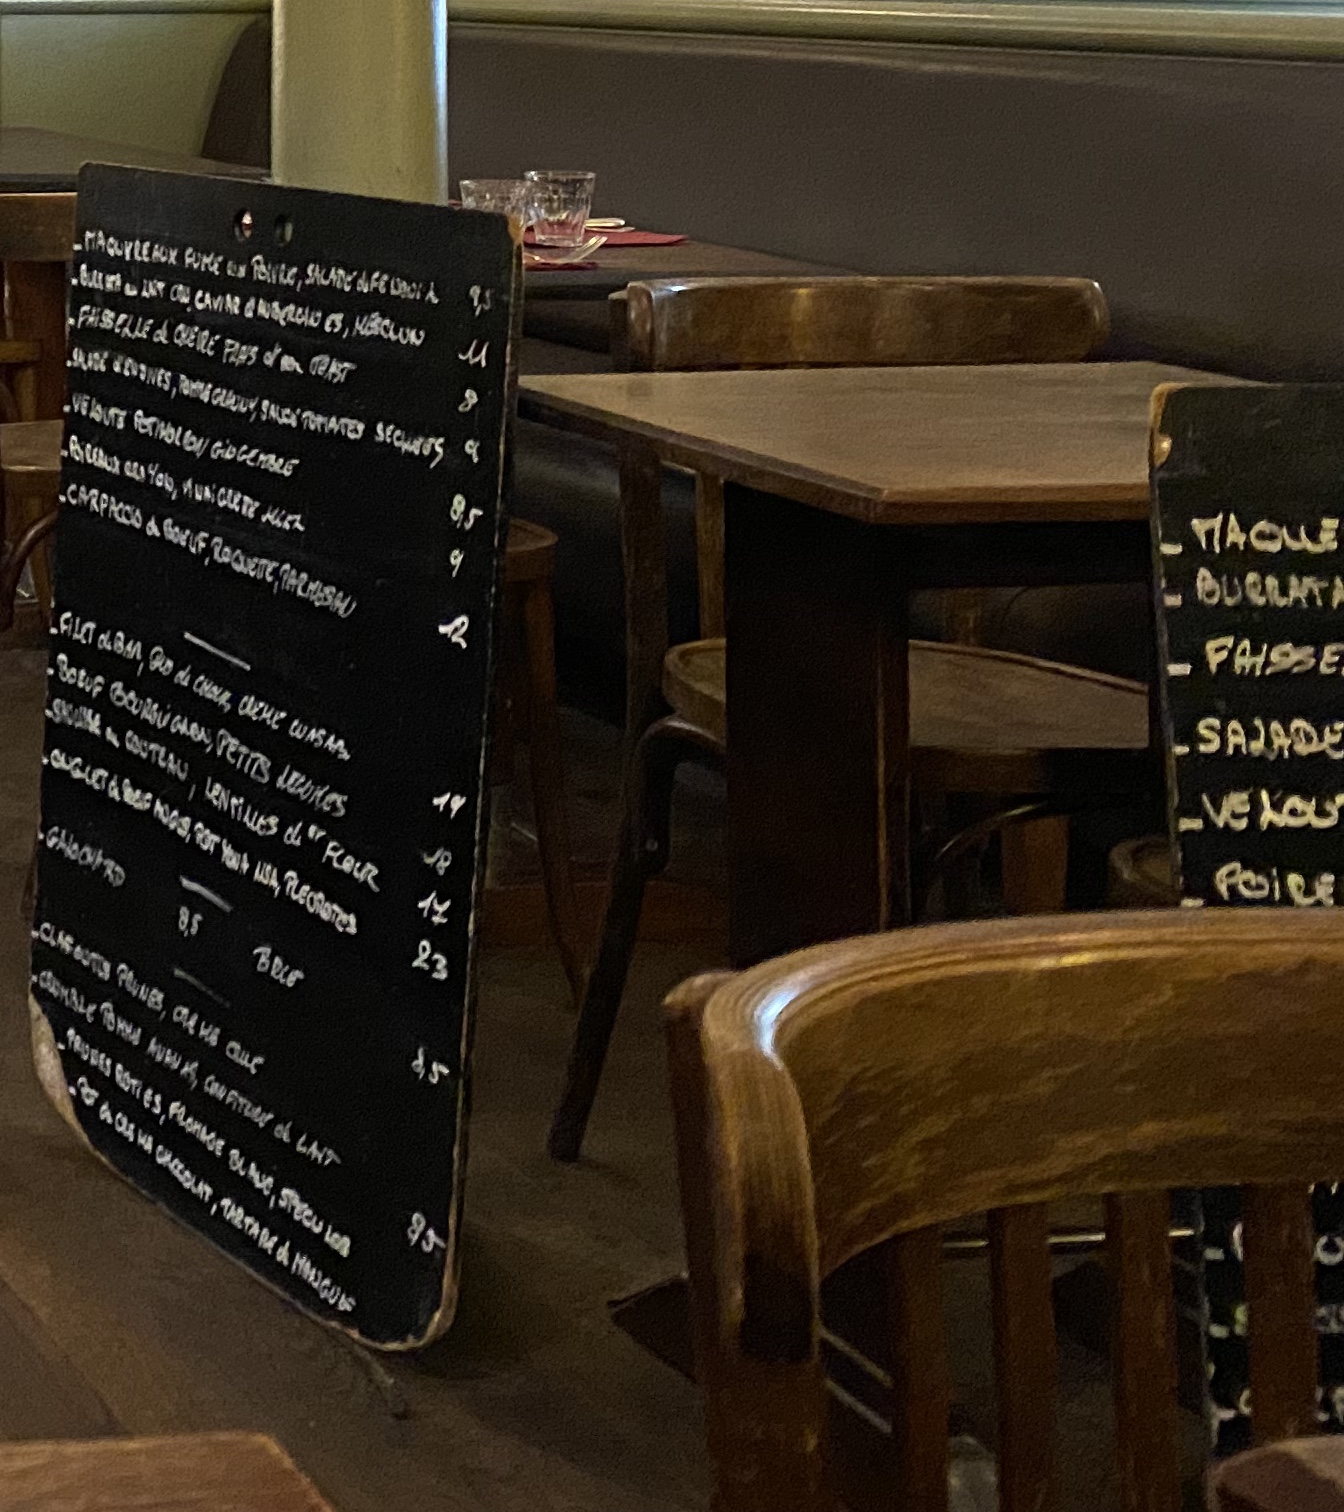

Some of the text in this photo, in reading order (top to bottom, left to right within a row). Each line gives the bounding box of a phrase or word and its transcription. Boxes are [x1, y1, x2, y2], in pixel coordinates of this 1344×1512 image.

[458, 389, 478, 412] 8
[450, 494, 483, 530] 8,5
[1190, 511, 1340, 555] MAQUE
[438, 615, 469, 649] 12
[1204, 634, 1344, 677] FAISSE
[1196, 716, 1344, 761] SALADE
[423, 848, 452, 875] 18
[1214, 860, 1336, 908] POIRE
[418, 891, 451, 925] 17
[412, 939, 447, 980] 23
